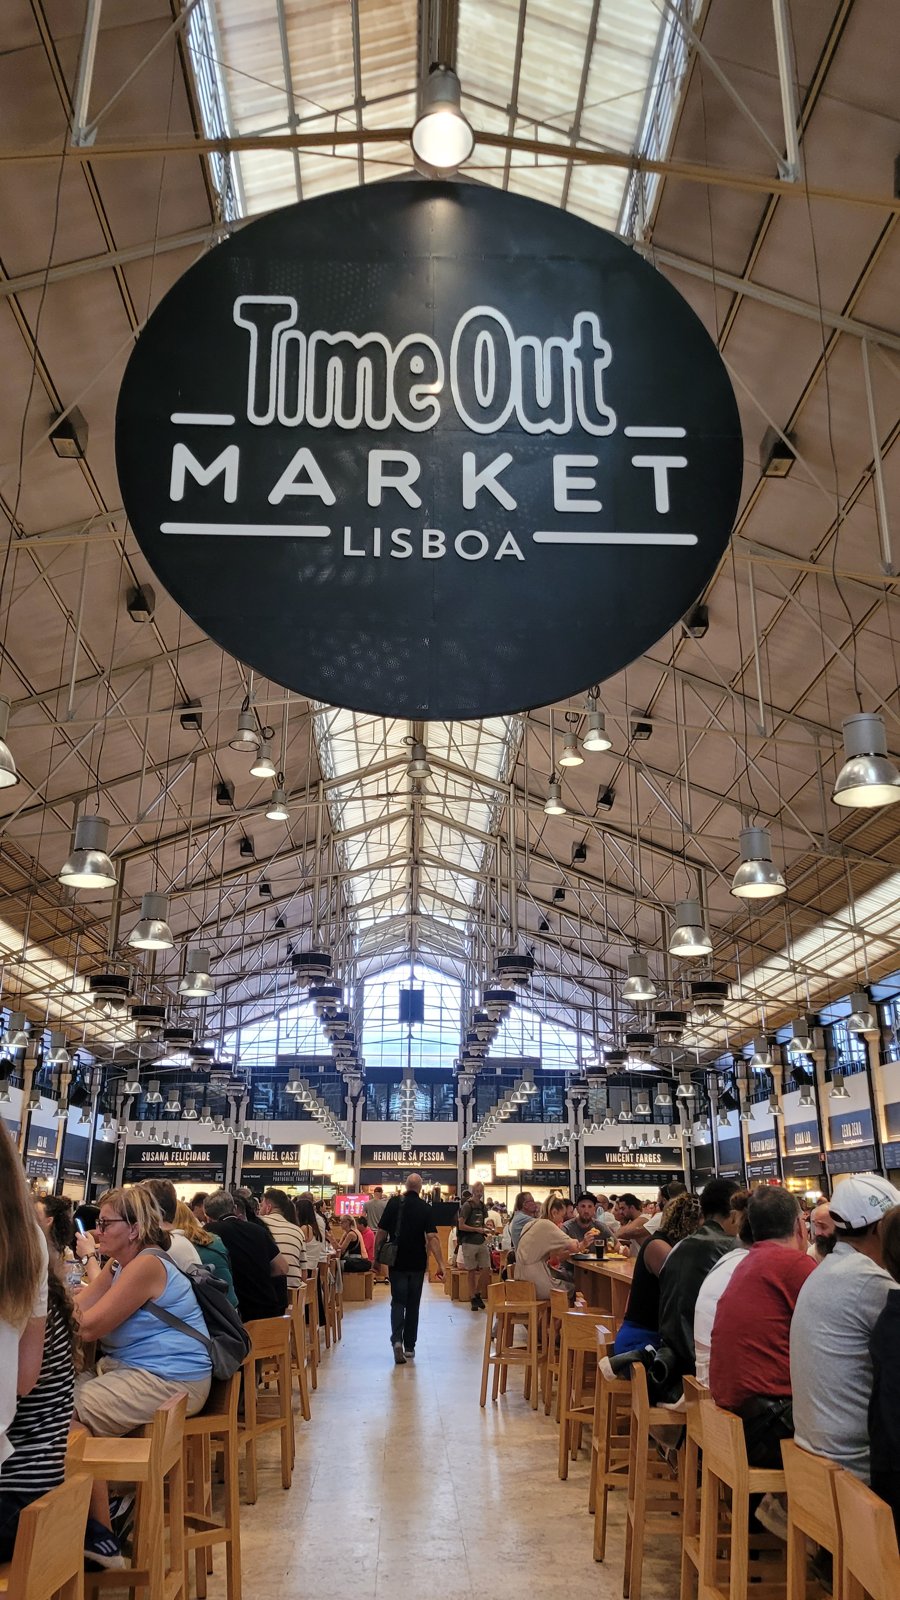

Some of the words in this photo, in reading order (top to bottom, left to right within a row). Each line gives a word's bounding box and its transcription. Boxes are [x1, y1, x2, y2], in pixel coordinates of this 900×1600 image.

[233, 295, 444, 433] Time
[450, 305, 618, 436] Out
[169, 442, 689, 514] MARKET
[342, 525, 526, 562] LISBOA
[141, 1151, 169, 1161] SUSANA
[171, 1151, 211, 1161] FELICIDADE
[253, 1151, 279, 1161] MIGUEL
[373, 1151, 406, 1161] HENRIQUE
[408, 1149, 417, 1161] SÁ
[419, 1151, 445, 1161] PESSOA
[533, 1152, 549, 1162] EIRA
[605, 1153, 634, 1163] VINCENT
[636, 1153, 661, 1163] FARGES
